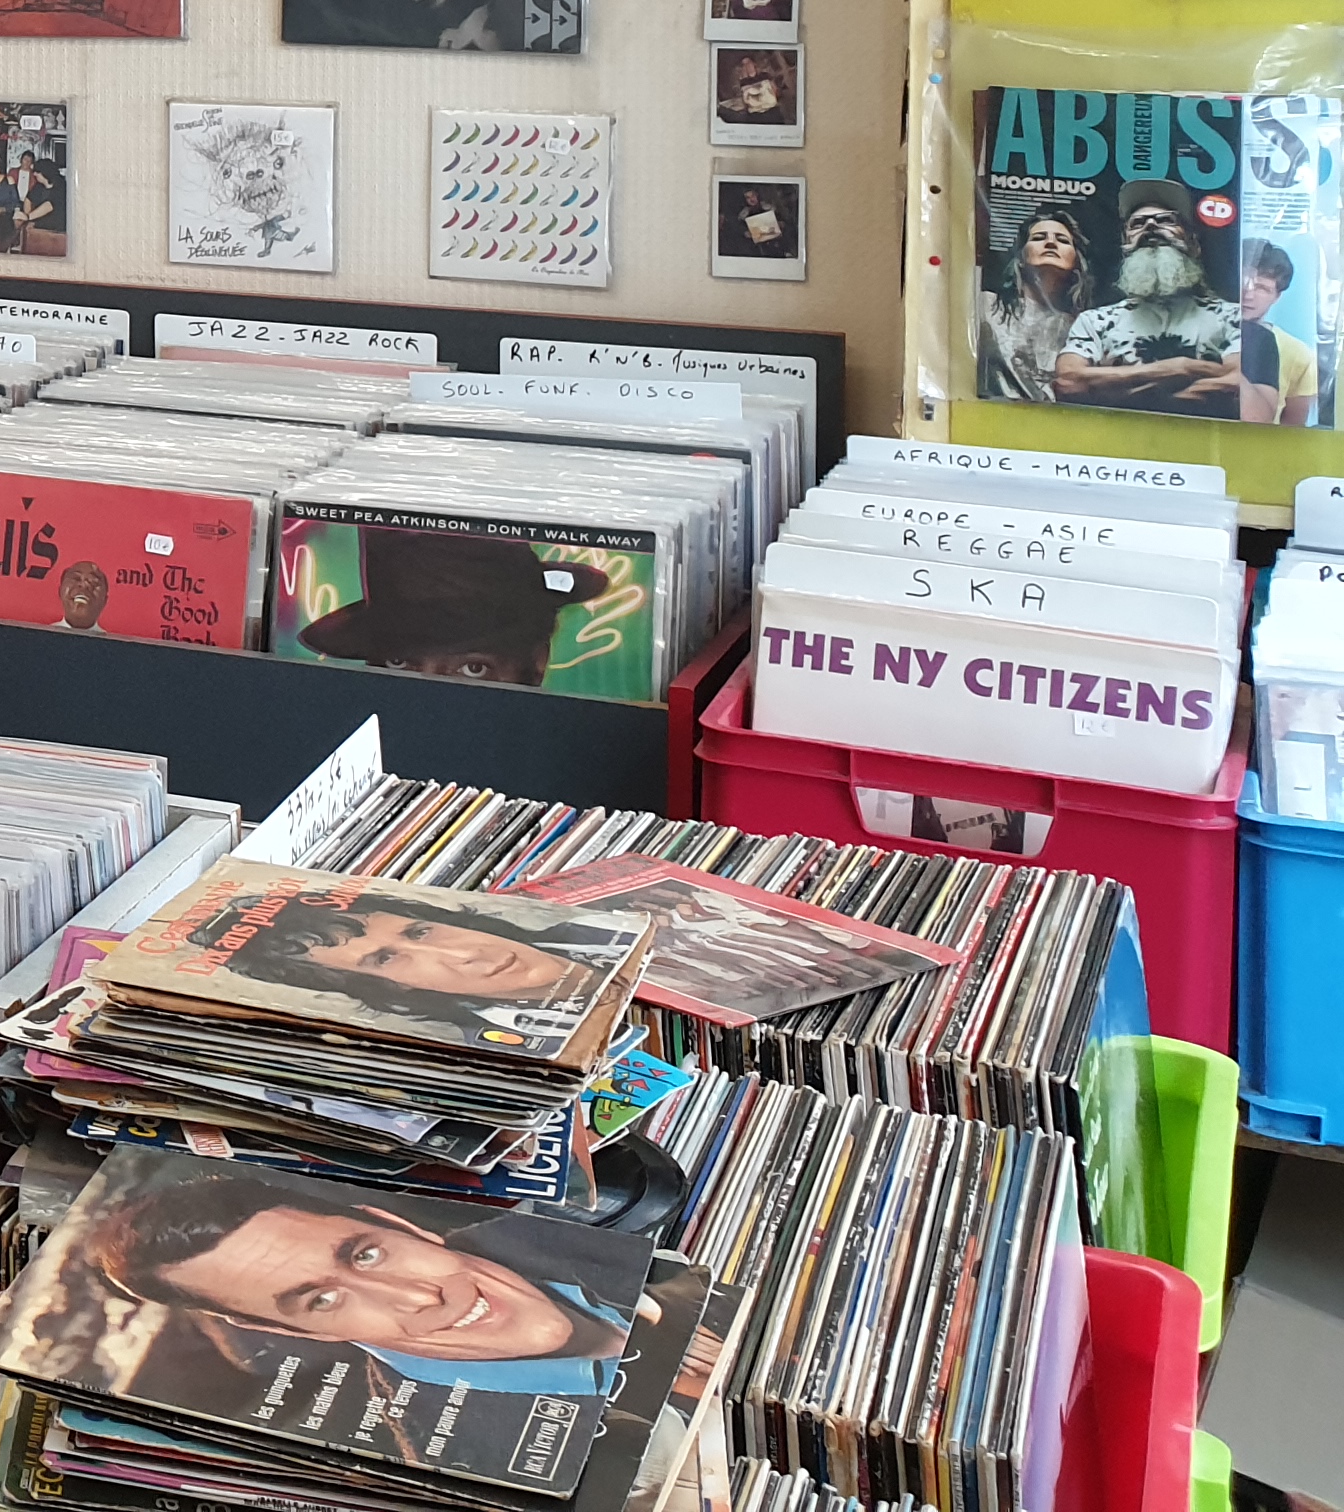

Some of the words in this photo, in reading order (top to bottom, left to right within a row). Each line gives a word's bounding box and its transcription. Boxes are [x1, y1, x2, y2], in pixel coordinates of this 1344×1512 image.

[991, 87, 1237, 191] ABUS
[1132, 95, 1153, 172] DANGEREUX
[990, 174, 1053, 192] MOON
[1053, 179, 1096, 196] DUO
[1198, 199, 1233, 218] CD
[178, 225, 194, 244] LA
[199, 228, 232, 244] SOURIS
[187, 318, 271, 343] JAZZ
[291, 326, 352, 348] JAZZ
[367, 332, 424, 354] ROCK
[618, 381, 696, 403] DISCO
[893, 447, 1014, 472] AFRIQUE
[1055, 462, 1187, 488] MAGHREB
[294, 504, 347, 522] SWEET
[353, 511, 385, 526] PEA
[389, 514, 472, 533] ATKINSON
[486, 523, 538, 538] DON'T
[544, 528, 595, 543] WALK
[599, 533, 643, 548] AWAY
[861, 503, 972, 530] EUROPE
[1041, 522, 1118, 547] ASIE
[902, 529, 1077, 565] REGGAE
[115, 563, 154, 588] and
[904, 569, 1047, 613] SKA
[763, 625, 856, 676] THE
[873, 641, 949, 690] NY
[962, 656, 1214, 731] CITIZENS
